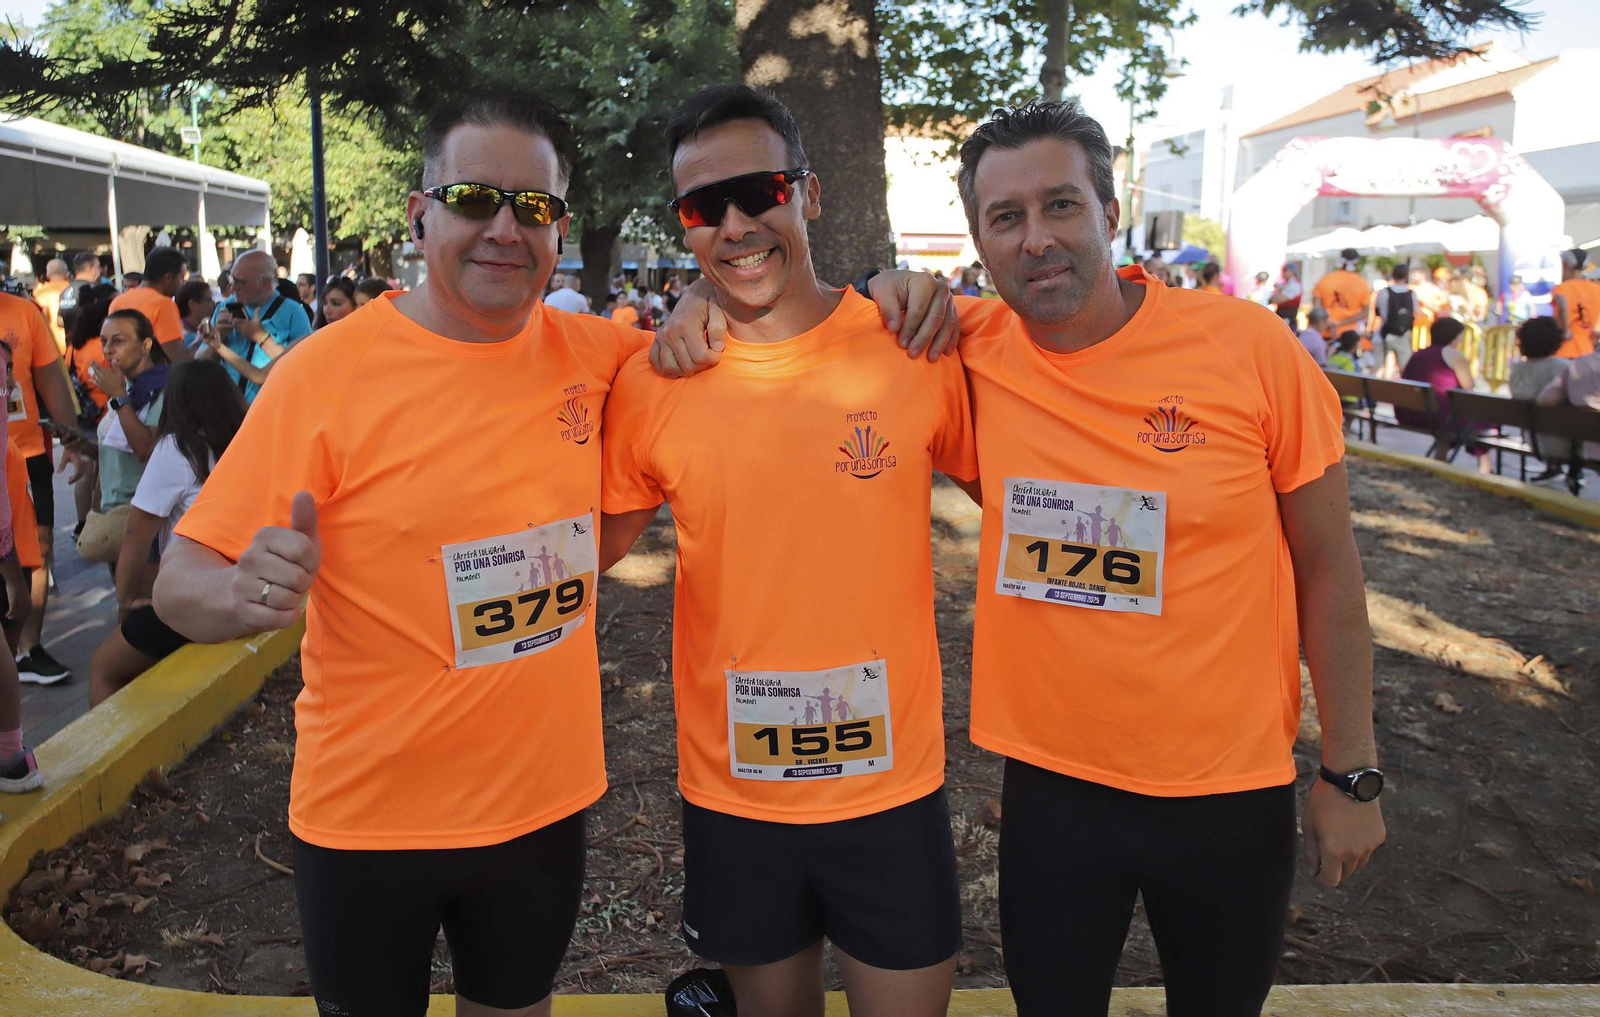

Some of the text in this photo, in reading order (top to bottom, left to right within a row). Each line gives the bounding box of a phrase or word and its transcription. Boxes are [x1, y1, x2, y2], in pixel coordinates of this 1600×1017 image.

[1012, 494, 1074, 511] POR UNA SONRISA
[454, 550, 526, 573] POR UNA SONRISA
[1026, 540, 1141, 585] 176
[1047, 577, 1106, 592] INFANTE ROJAS, DANIEL
[1060, 592, 1087, 602] SEPTIEMBRE
[1087, 596, 1100, 604] 2025
[474, 578, 584, 637] 379
[735, 685, 801, 698] POR UNA SONRISA
[753, 720, 872, 756] 155
[798, 768, 825, 776] SEPTIEMBRE
